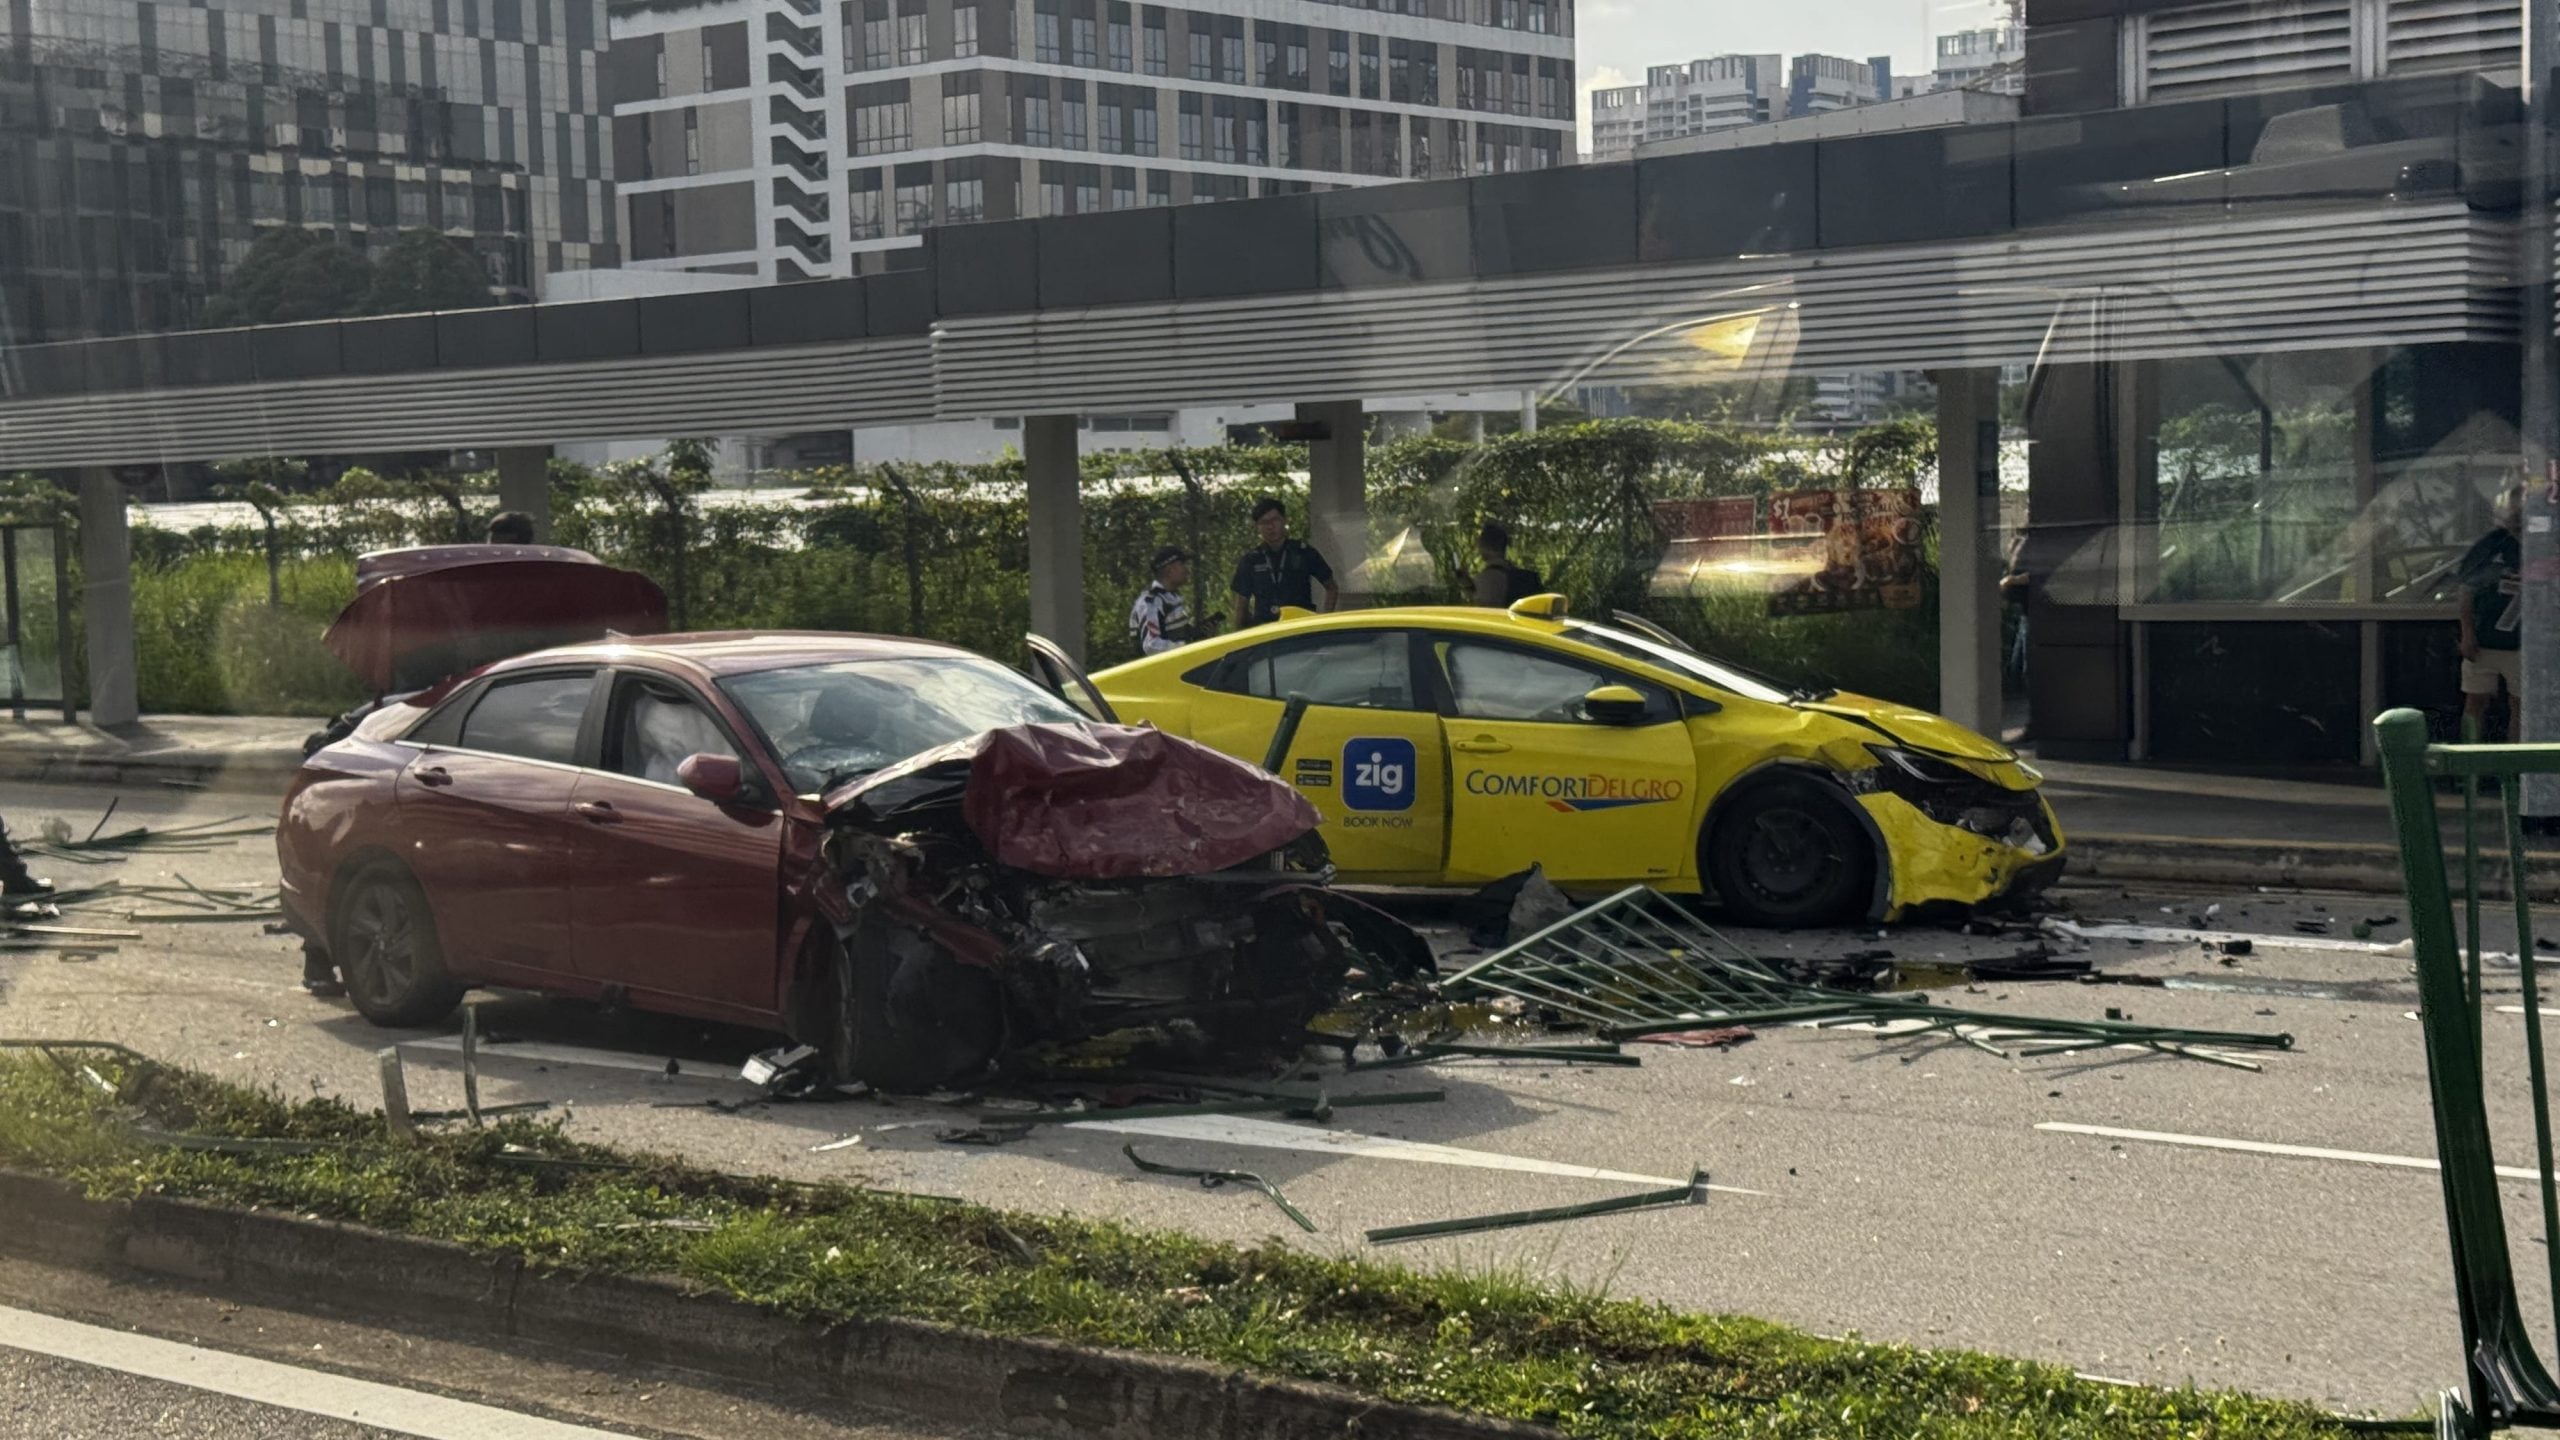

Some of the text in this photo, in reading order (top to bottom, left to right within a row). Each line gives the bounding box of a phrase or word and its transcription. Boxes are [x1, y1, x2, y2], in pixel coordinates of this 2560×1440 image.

[1355, 752, 1403, 794] zig
[1343, 816, 1413, 828] BOOK NOW
